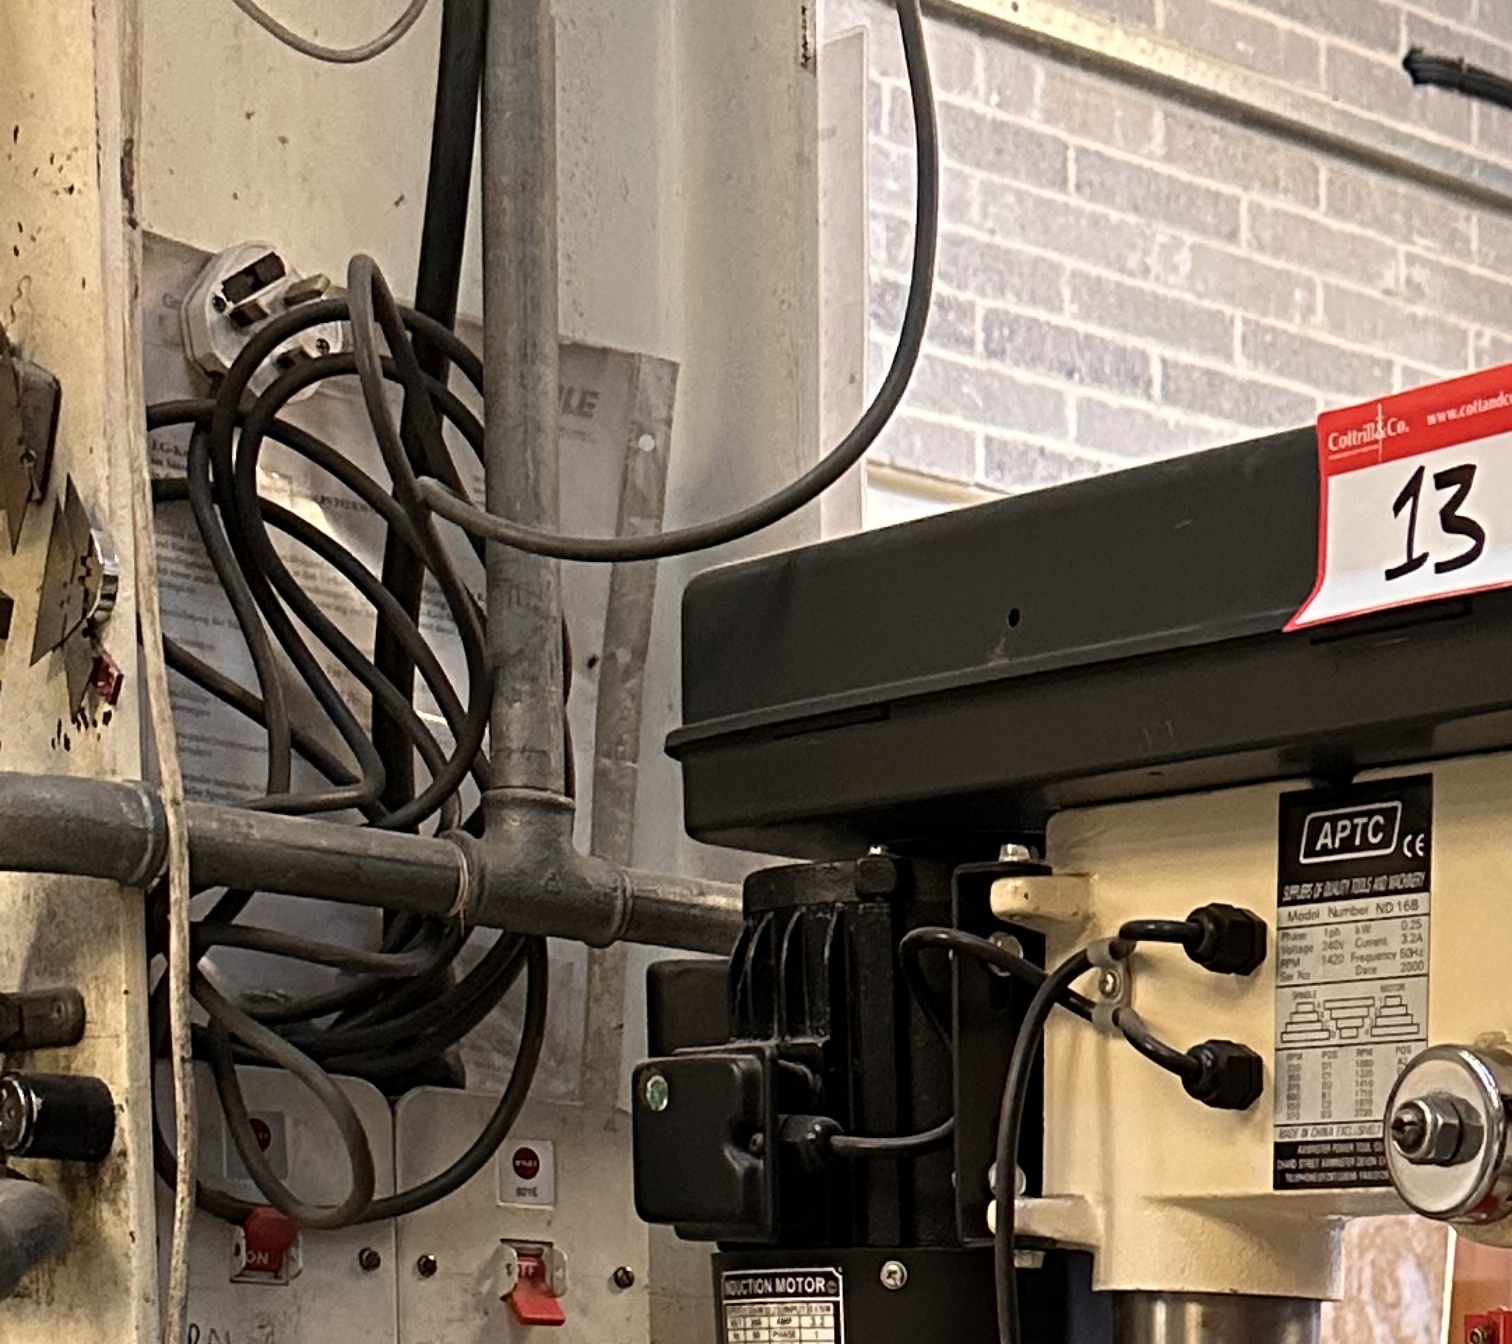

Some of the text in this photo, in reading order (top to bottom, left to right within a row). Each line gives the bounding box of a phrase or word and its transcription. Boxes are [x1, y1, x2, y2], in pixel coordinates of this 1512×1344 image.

[1384, 462, 1486, 581] 13
[1315, 814, 1385, 851] APTC
[1287, 908, 1320, 922] Model
[1328, 903, 1369, 918] Number
[246, 1249, 269, 1265] ON
[775, 1276, 826, 1293] MOTOR
